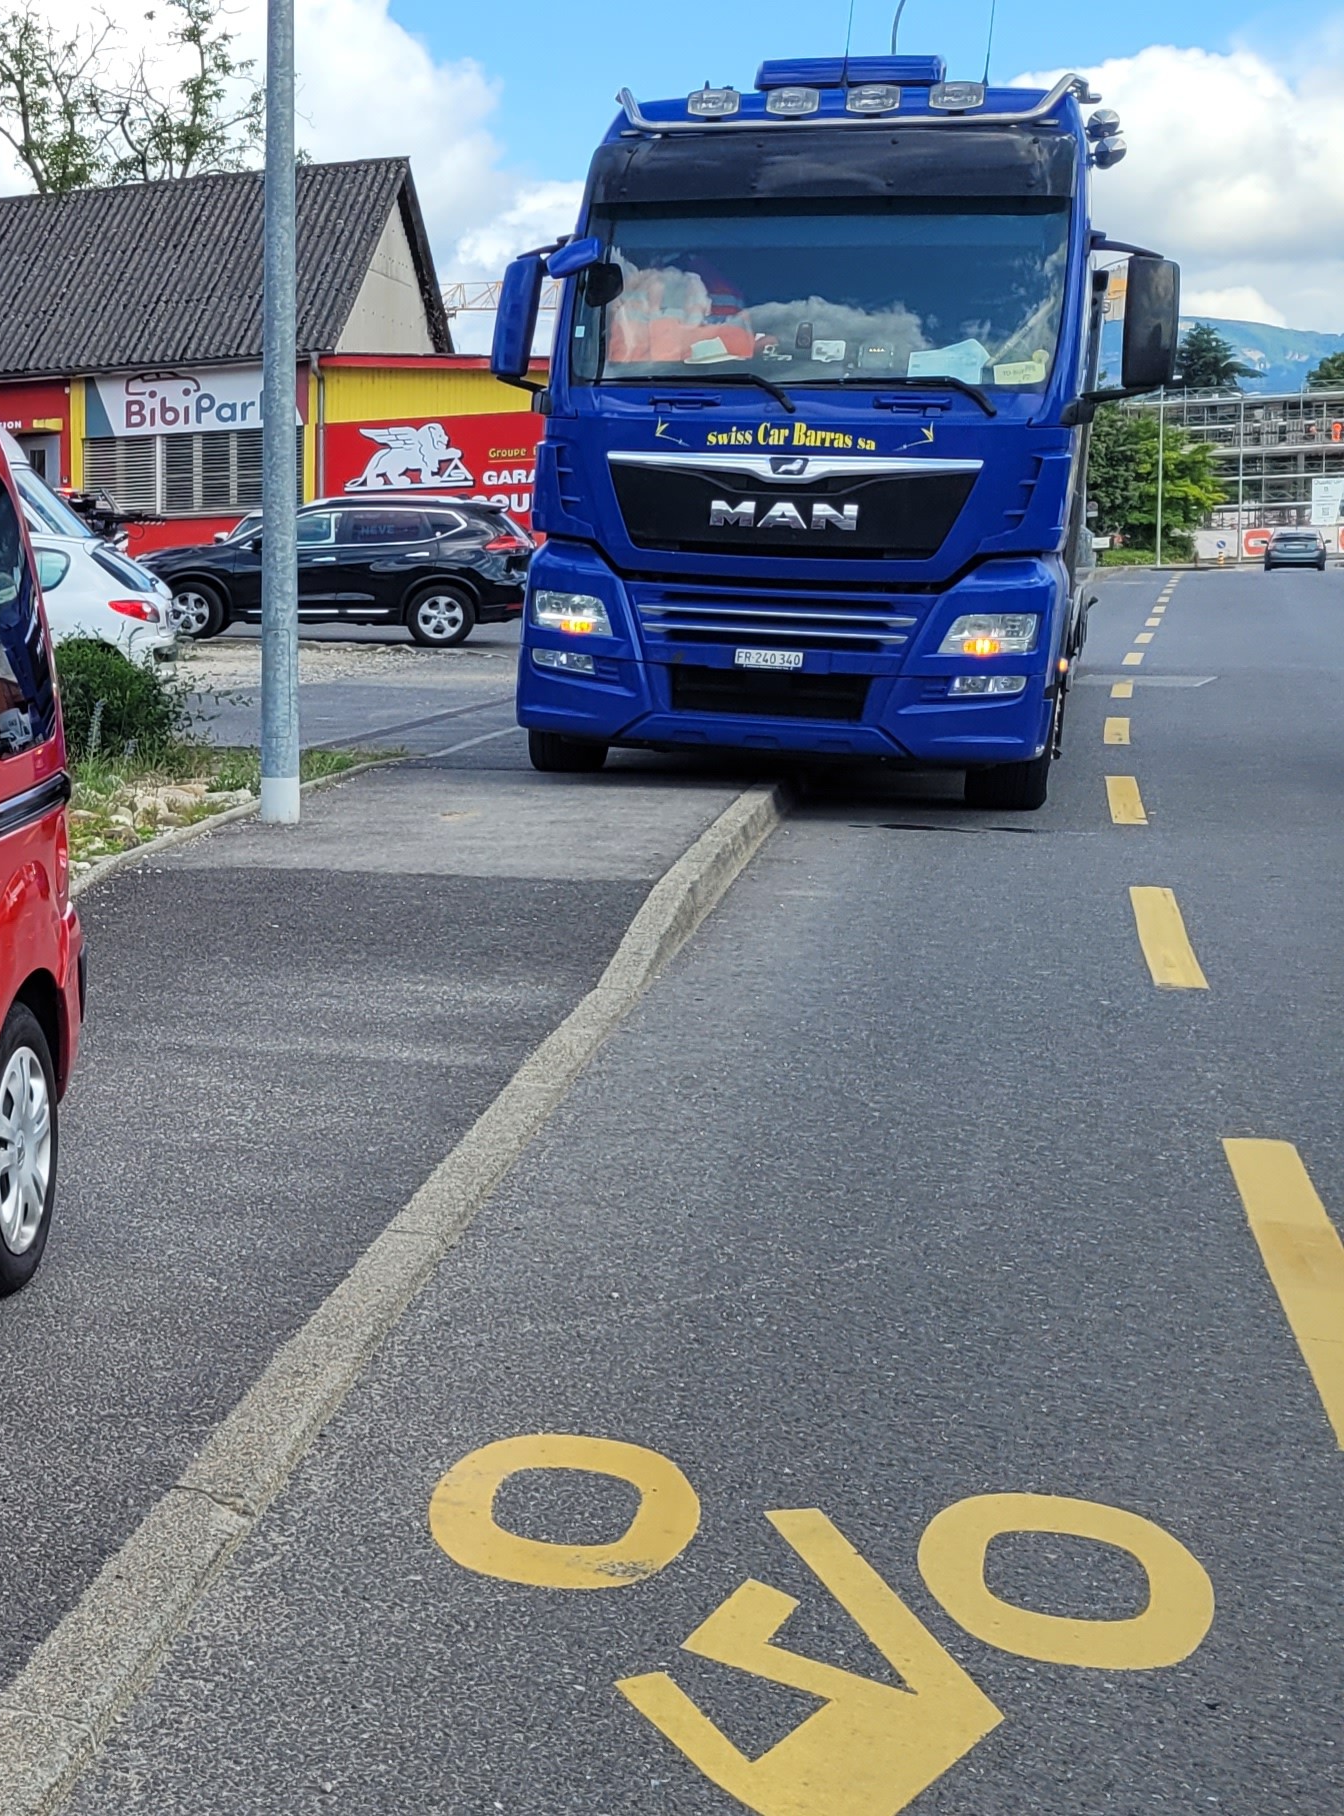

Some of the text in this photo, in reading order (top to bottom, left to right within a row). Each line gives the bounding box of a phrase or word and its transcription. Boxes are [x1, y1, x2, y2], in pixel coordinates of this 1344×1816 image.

[125, 390, 264, 428] BibiPar
[706, 422, 876, 451] swiss Car Barras sa
[488, 448, 527, 458] Groupe
[709, 500, 859, 531] MAN
